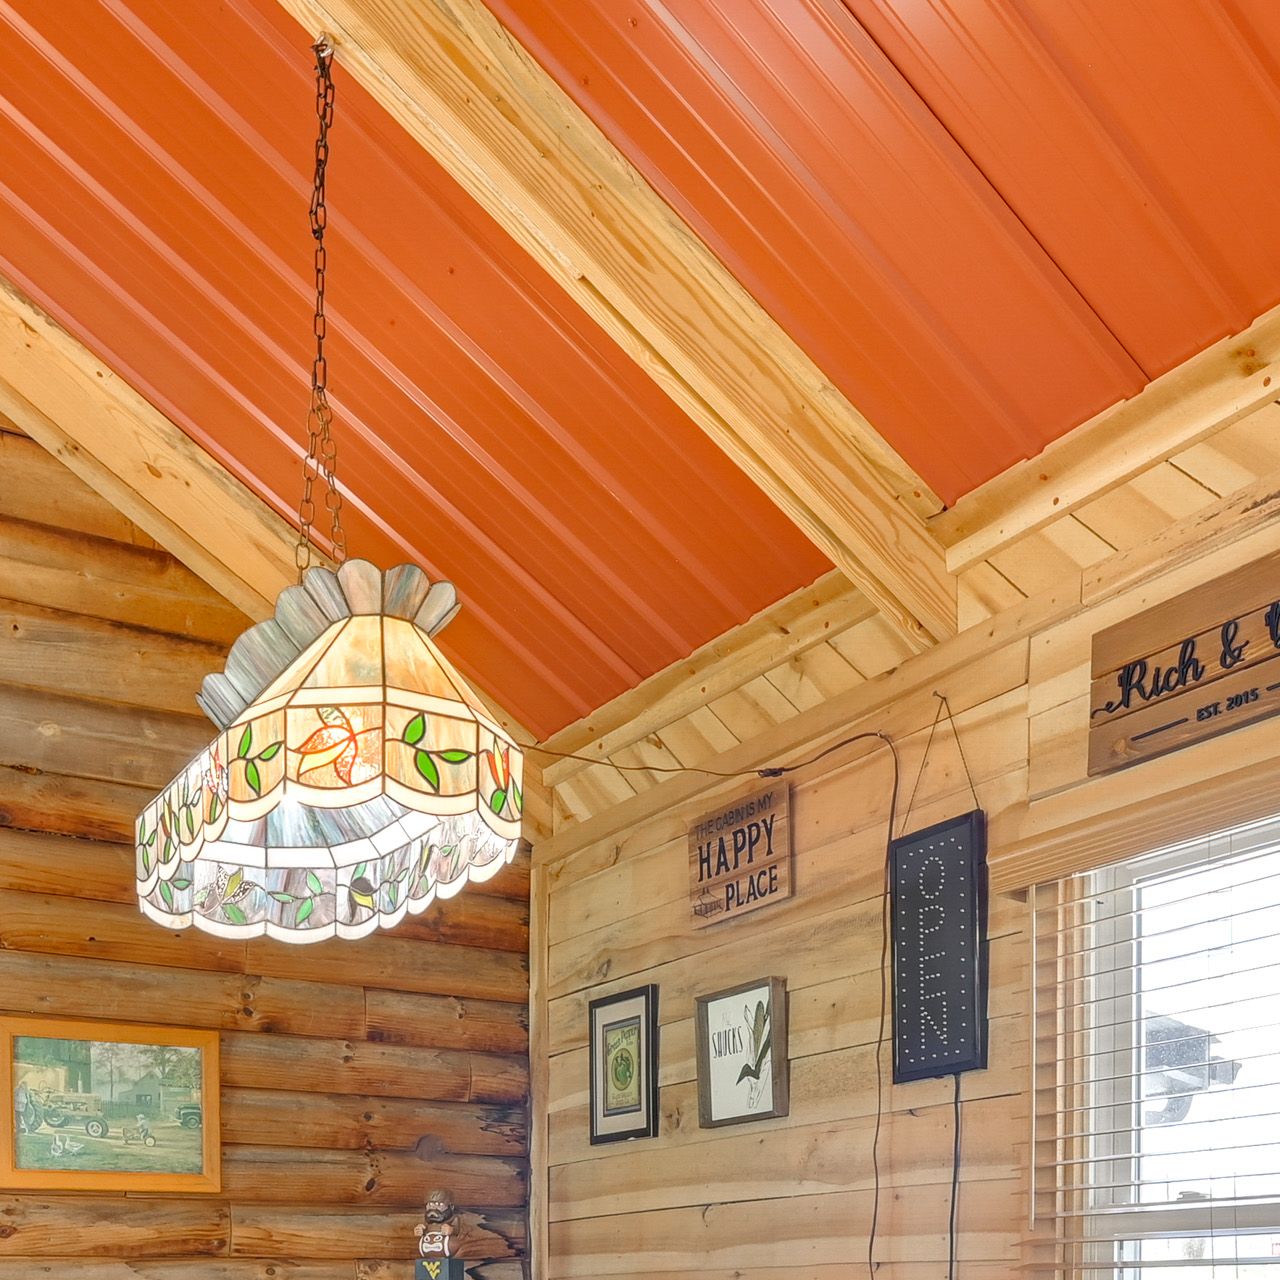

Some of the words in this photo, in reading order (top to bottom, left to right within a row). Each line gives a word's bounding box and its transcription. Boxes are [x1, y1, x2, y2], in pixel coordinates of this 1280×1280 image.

[1106, 638, 1205, 711] Rich
[1220, 619, 1250, 669] &
[1196, 701, 1222, 721] EST.
[1226, 688, 1259, 711] 2015
[695, 819, 714, 840] THE
[715, 807, 744, 832] CABIN
[745, 801, 755, 818] IS
[757, 791, 773, 814] MY
[698, 813, 776, 883] HAPPY
[724, 865, 778, 912] PLACE
[919, 856, 947, 1049] OPEN
[711, 1025, 743, 1059] SHUCKS
